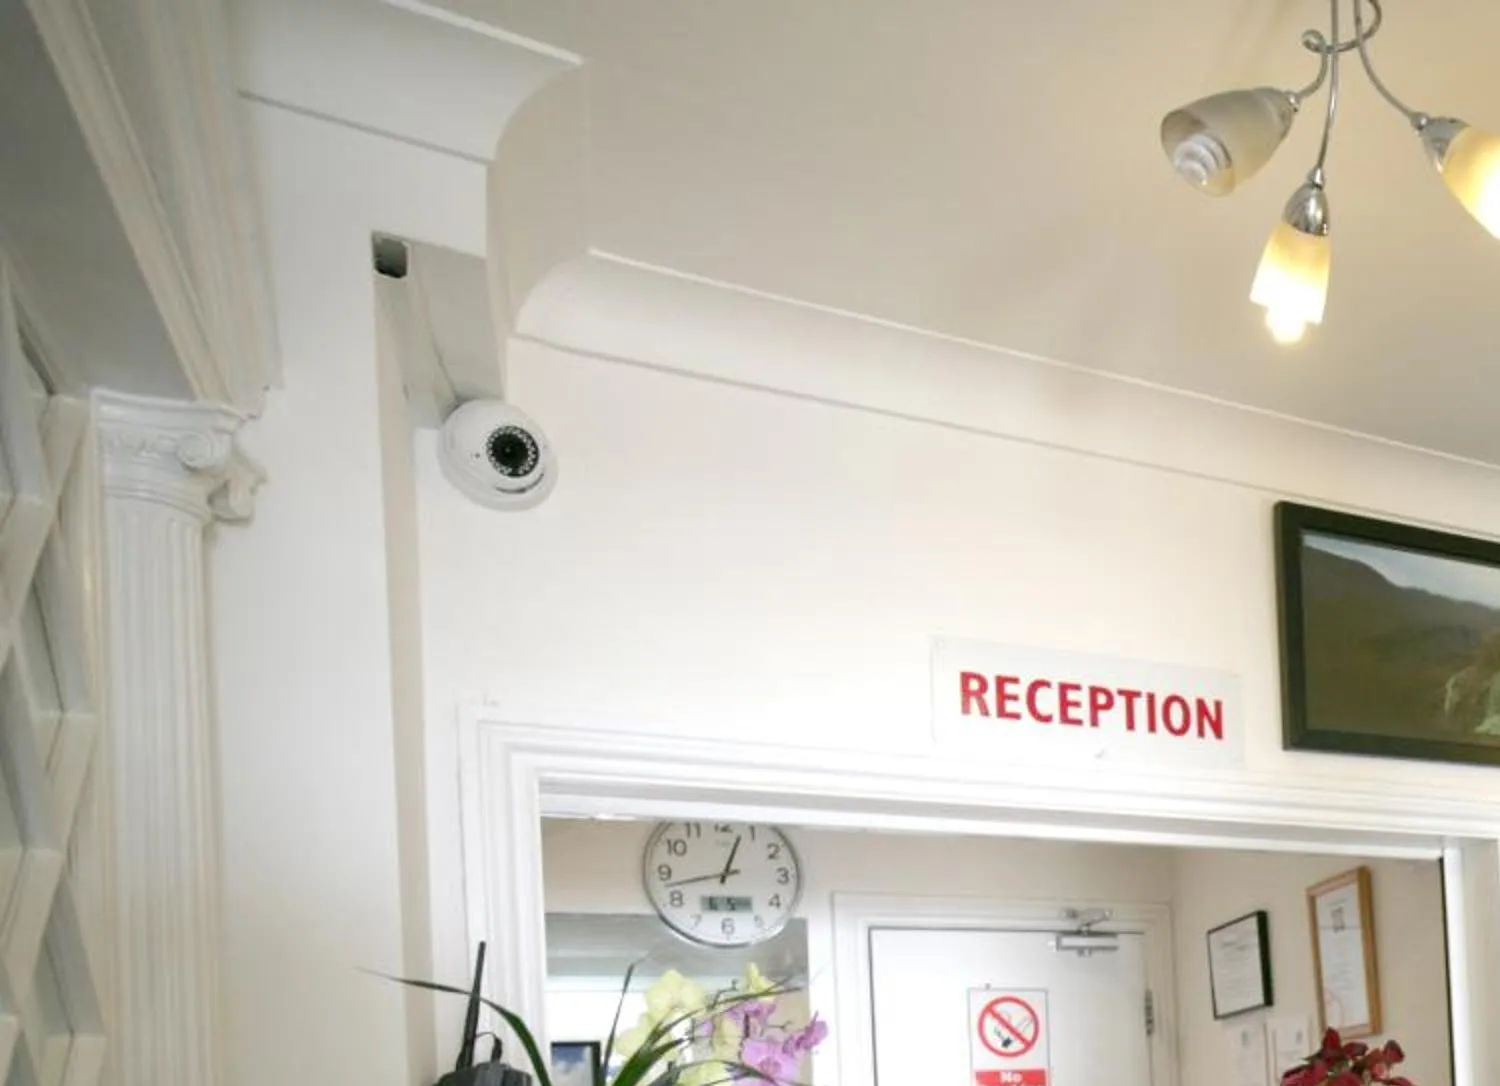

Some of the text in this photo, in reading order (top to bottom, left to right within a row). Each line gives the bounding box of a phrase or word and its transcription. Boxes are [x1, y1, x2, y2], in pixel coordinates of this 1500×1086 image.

[959, 671, 1224, 740] RECEPTION
[685, 822, 701, 839] 11
[666, 838, 688, 857] 10
[767, 843, 781, 861] 2
[657, 864, 672, 882] 9
[776, 867, 790, 885] 3
[669, 890, 684, 908] 8
[768, 893, 782, 909] 4
[721, 918, 735, 935] 6
[1000, 1070, 1023, 1084] No
